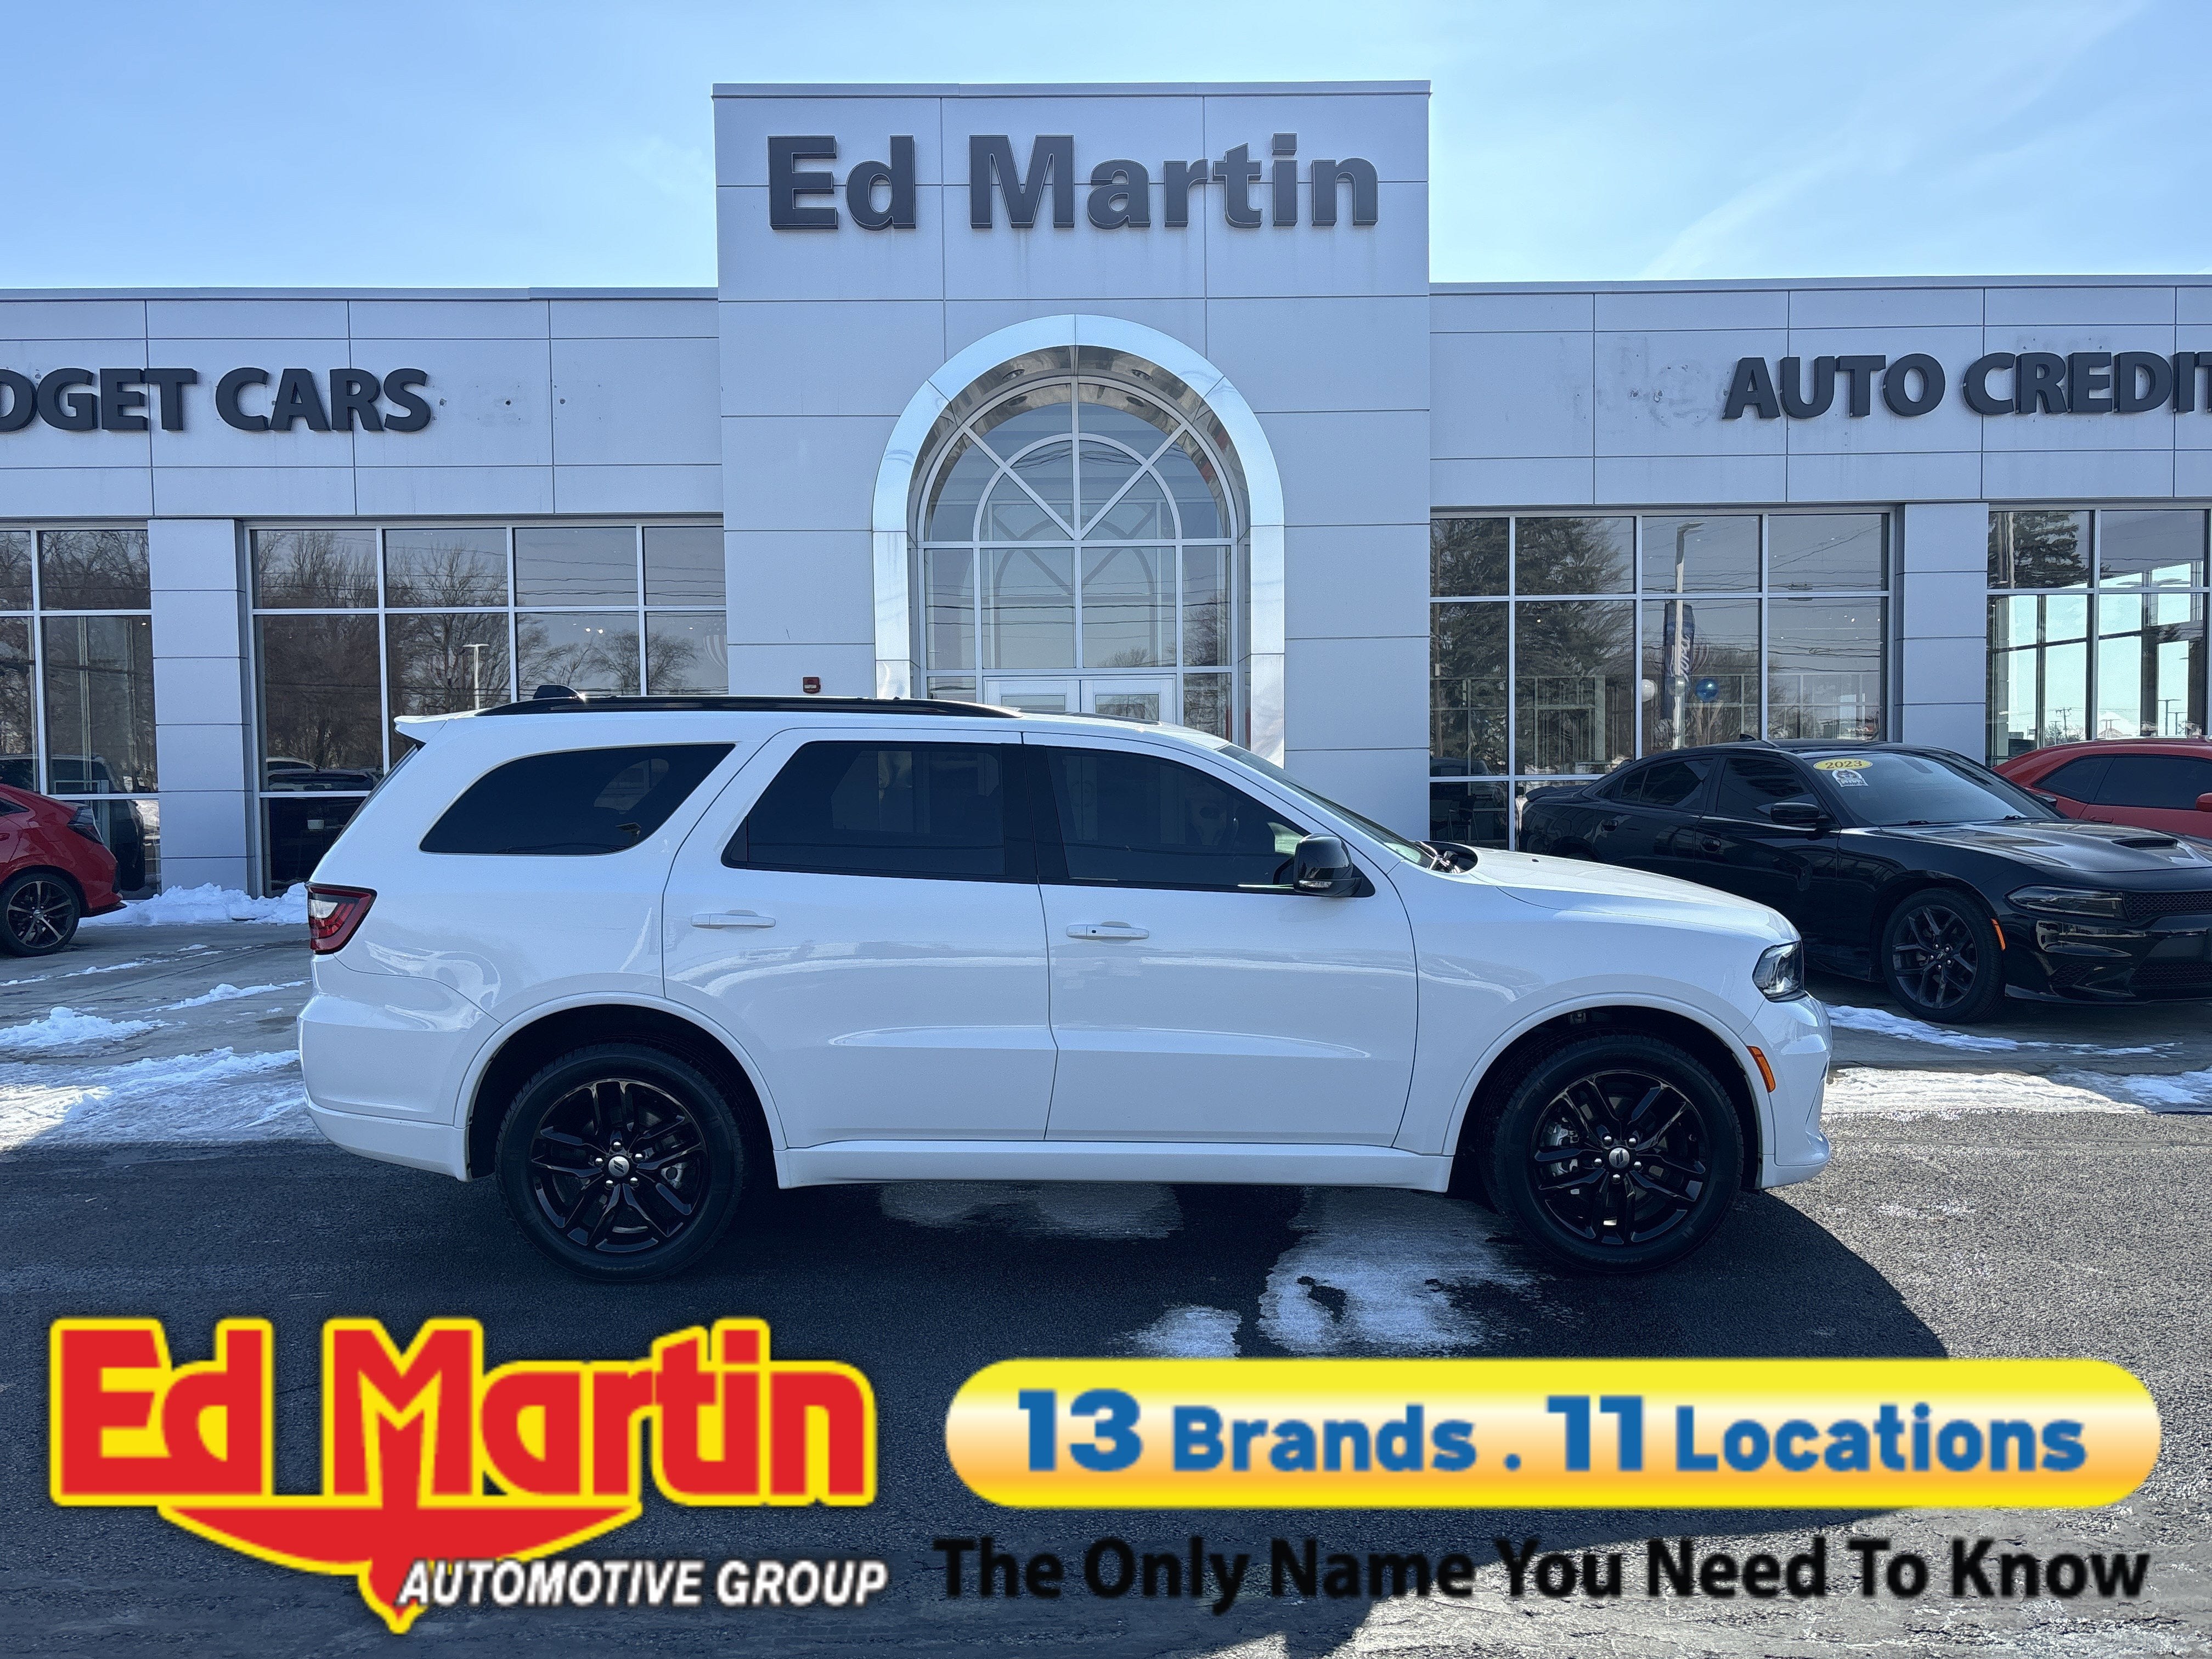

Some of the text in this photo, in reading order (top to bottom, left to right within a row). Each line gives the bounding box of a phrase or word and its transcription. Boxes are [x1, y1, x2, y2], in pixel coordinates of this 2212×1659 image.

[768, 133, 1378, 230] Ed Martin
[215, 367, 431, 432] CARS
[1722, 353, 1945, 420] AUTO
[1825, 760, 1863, 769] 2023
